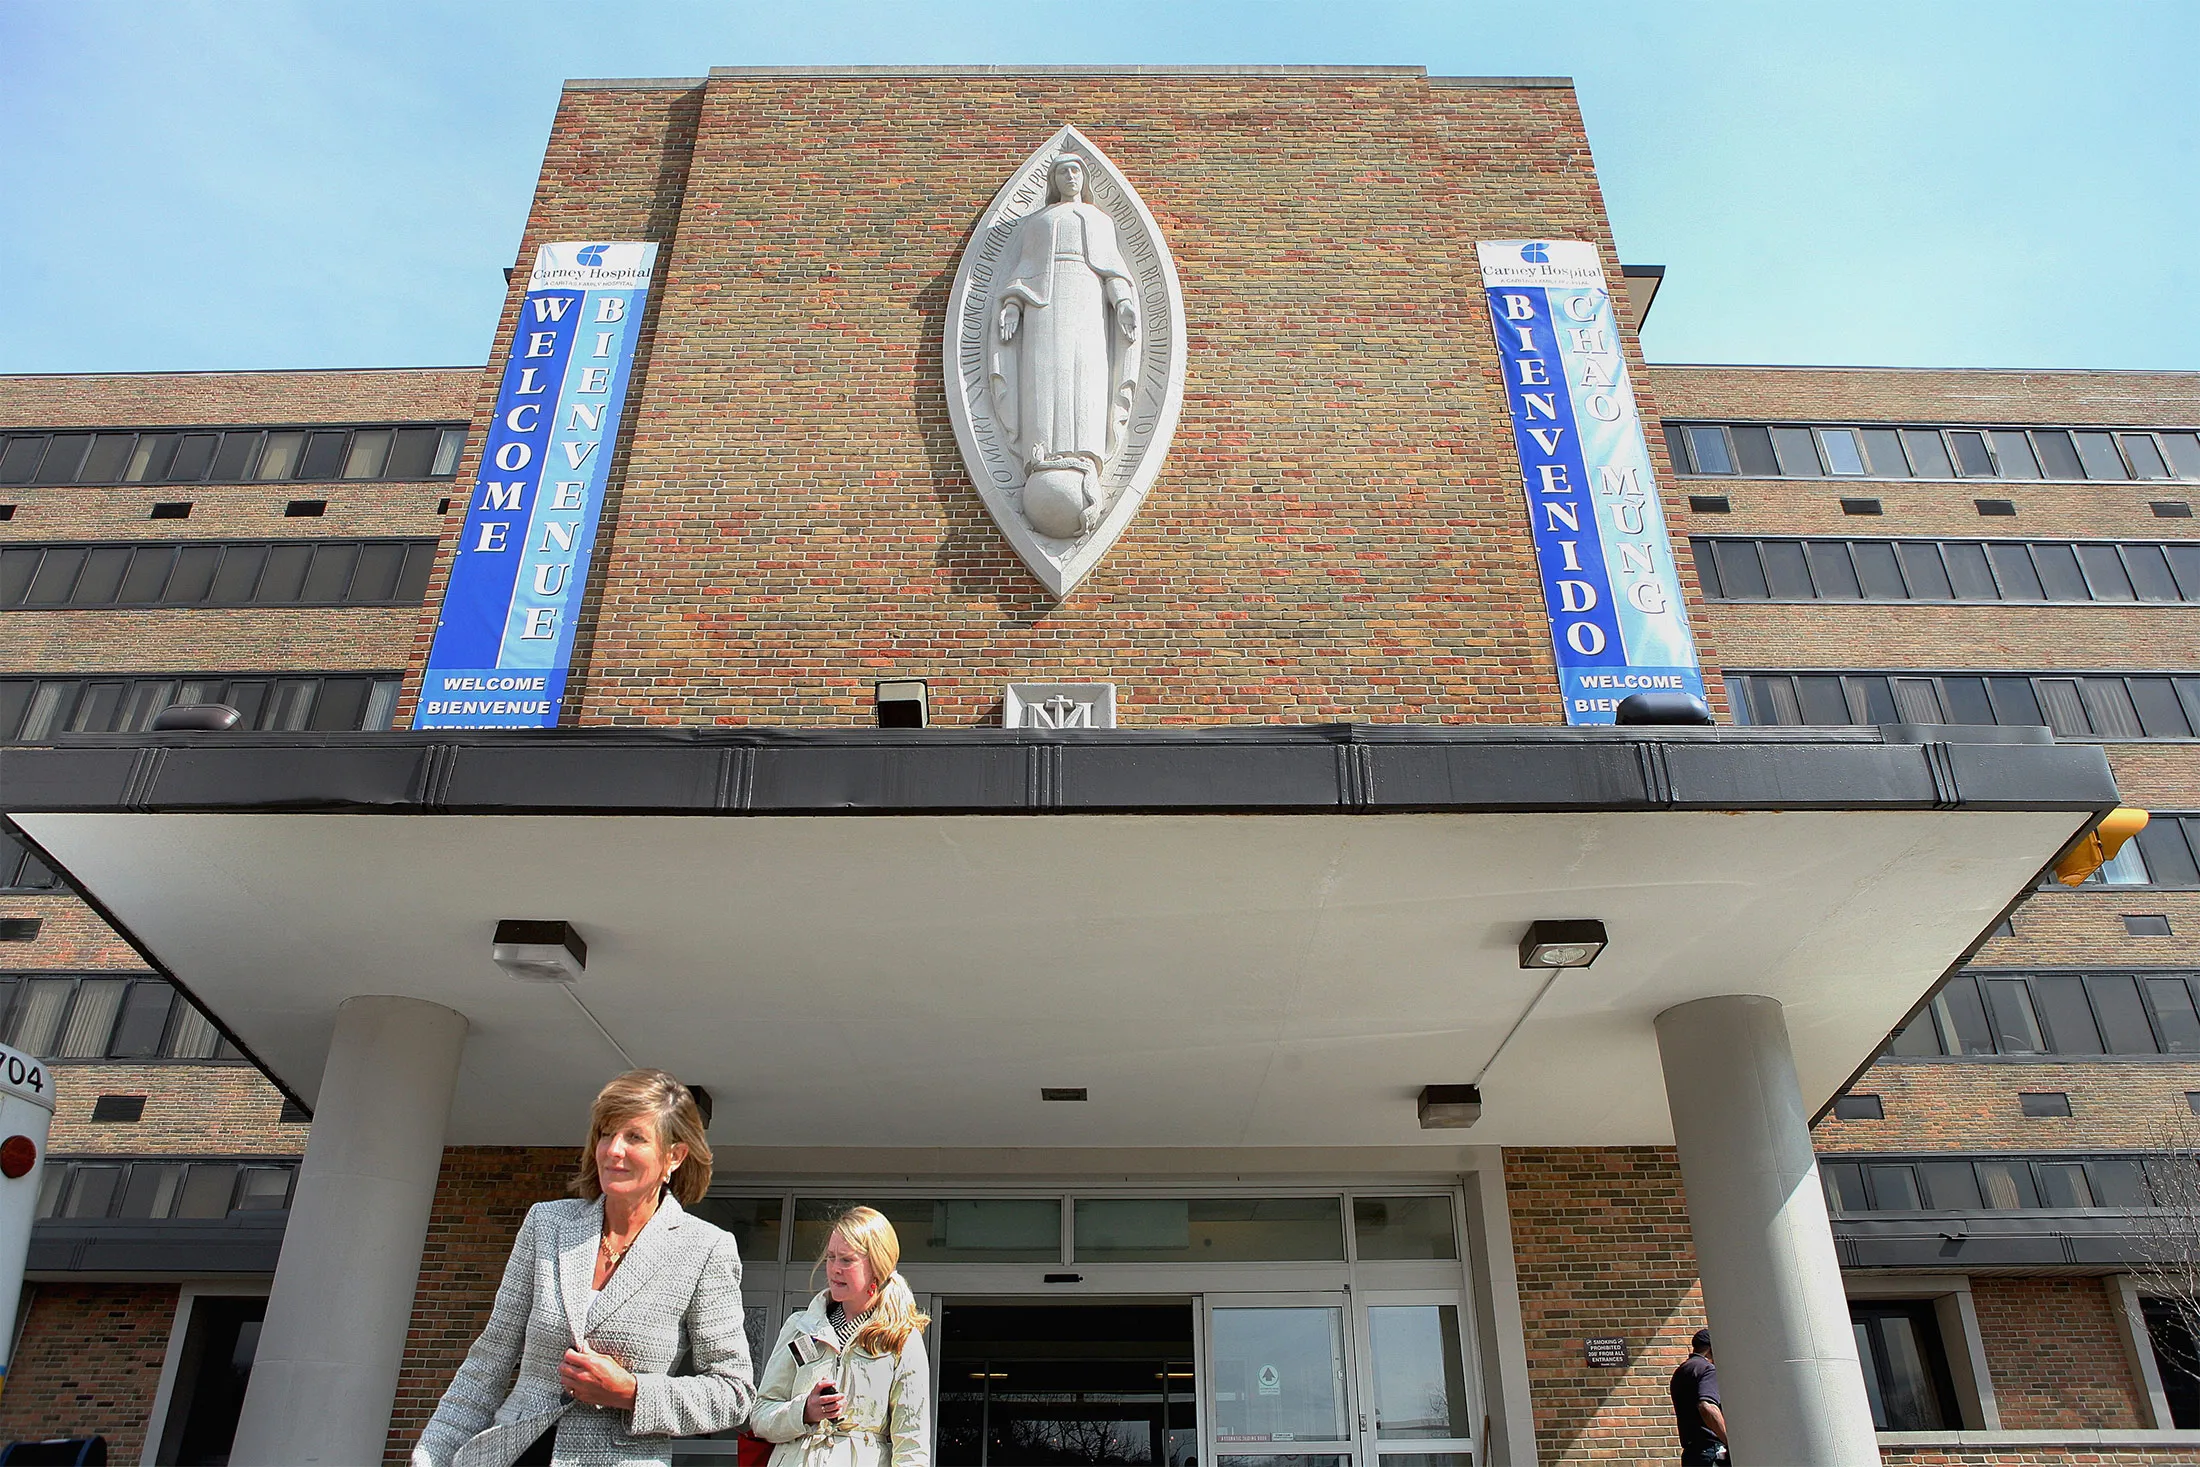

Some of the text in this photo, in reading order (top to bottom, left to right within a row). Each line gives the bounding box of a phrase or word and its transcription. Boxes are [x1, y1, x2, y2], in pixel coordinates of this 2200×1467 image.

[1012, 183, 1037, 210] SIN
[1094, 177, 1117, 200] US
[1106, 194, 1137, 231] WHO
[979, 203, 1022, 263] WITHOUT
[1126, 229, 1155, 267] HAVE
[533, 267, 651, 280] Carney Hospital
[1483, 265, 1601, 279] Carney Hospital
[962, 263, 993, 340] CONCEIVED
[1139, 265, 1169, 337] RECOURSE
[473, 296, 575, 552] WELCOME
[971, 414, 1005, 464] MARY
[1133, 410, 1158, 435] TO
[520, 297, 625, 640] BIENVENUE
[992, 470, 1013, 483] O
[1111, 440, 1147, 481] THEE
[1502, 294, 1606, 656] BIENVENIDO
[444, 677, 546, 691] WELCOME
[1579, 675, 1684, 689] WELCOME
[426, 701, 551, 715] BIENVENUE
